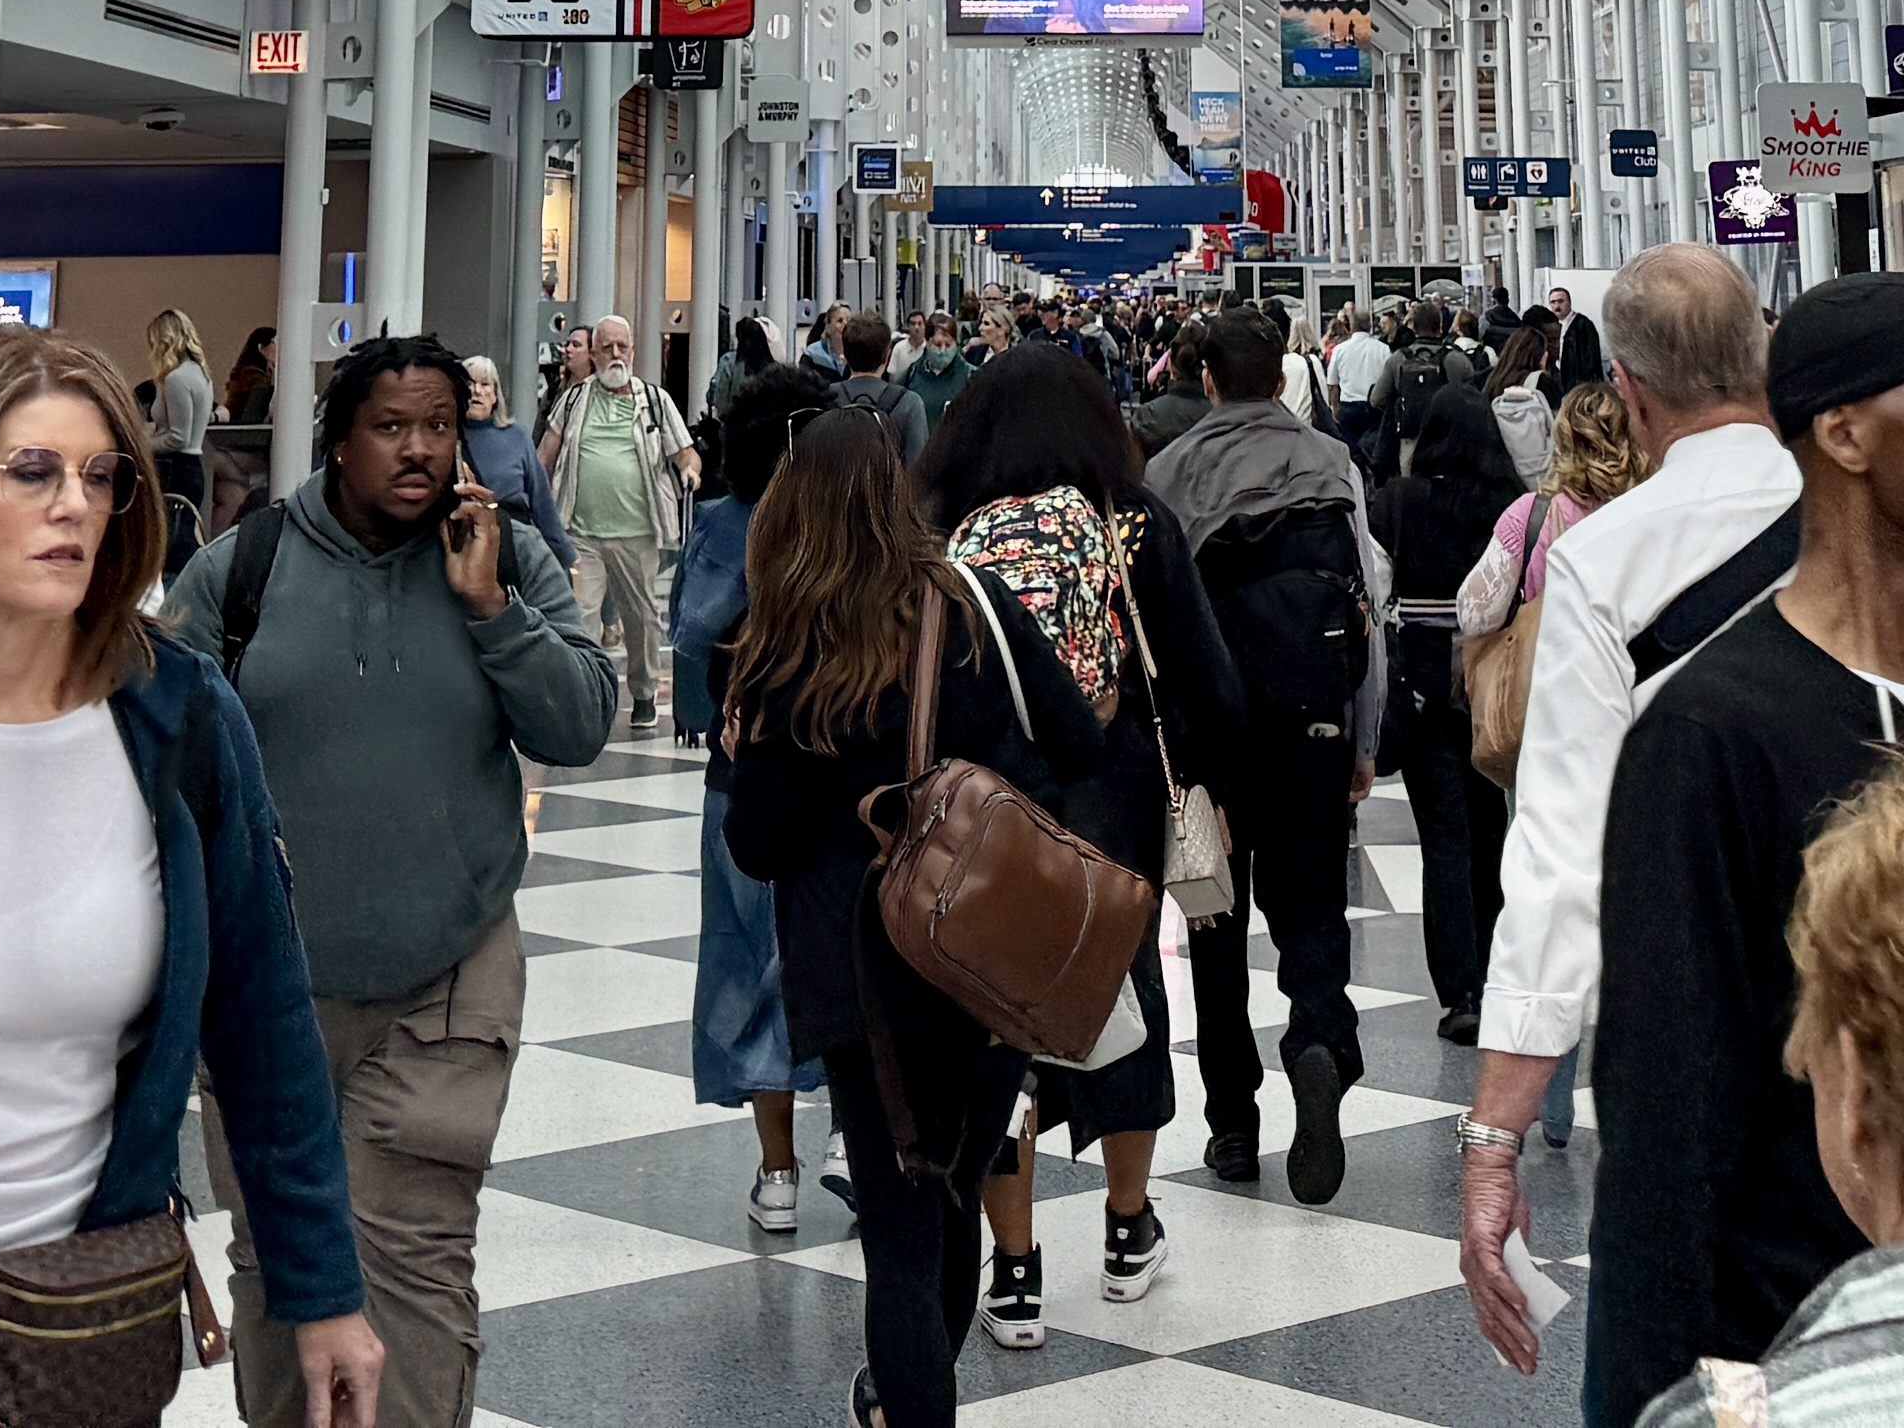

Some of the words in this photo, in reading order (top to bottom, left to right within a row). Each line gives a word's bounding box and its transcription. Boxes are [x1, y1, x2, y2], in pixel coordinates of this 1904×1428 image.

[256, 31, 302, 63] EXIT
[1060, 37, 1094, 45] Channel
[758, 101, 800, 112] JOHNSTON
[1762, 136, 1870, 157] SMOOTHIE
[1633, 155, 1657, 167] Club
